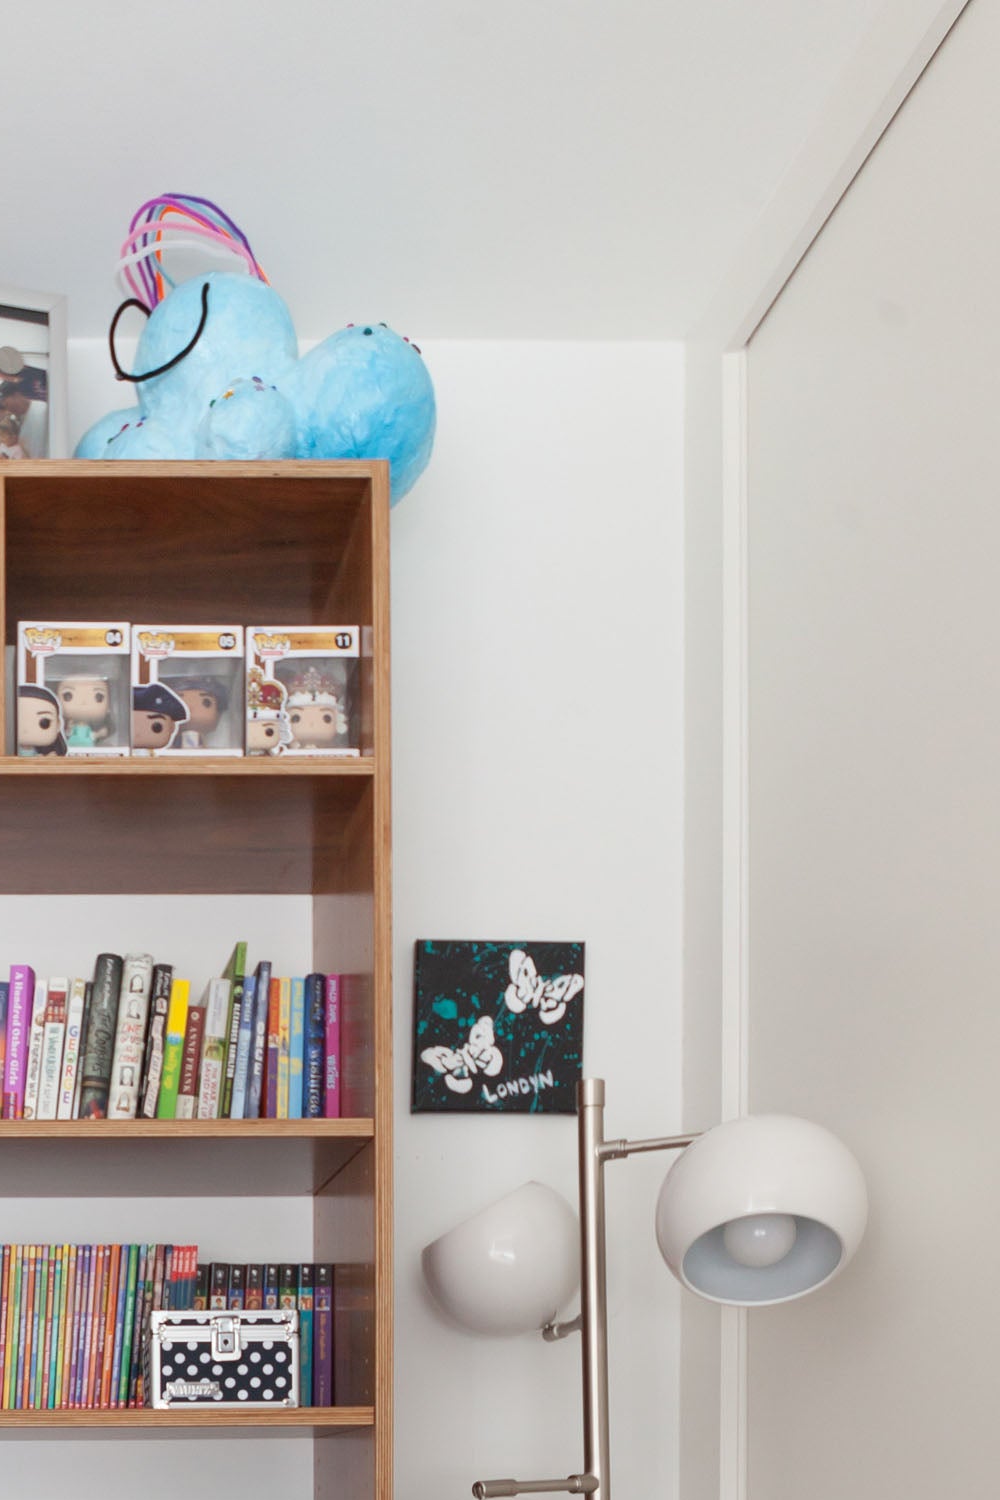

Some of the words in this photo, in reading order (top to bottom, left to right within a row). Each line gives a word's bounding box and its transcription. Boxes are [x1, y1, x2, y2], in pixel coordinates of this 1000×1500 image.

[335, 634, 352, 648] 11
[12, 982, 23, 1026] Hundred
[187, 1026, 197, 1054] ANNE
[9, 1060, 20, 1085] Girls
[62, 1025, 79, 1104] GEORGE
[182, 1057, 194, 1092] FRANK
[227, 1044, 236, 1078] HAMILTON
[483, 1069, 554, 1103] LONDYN
